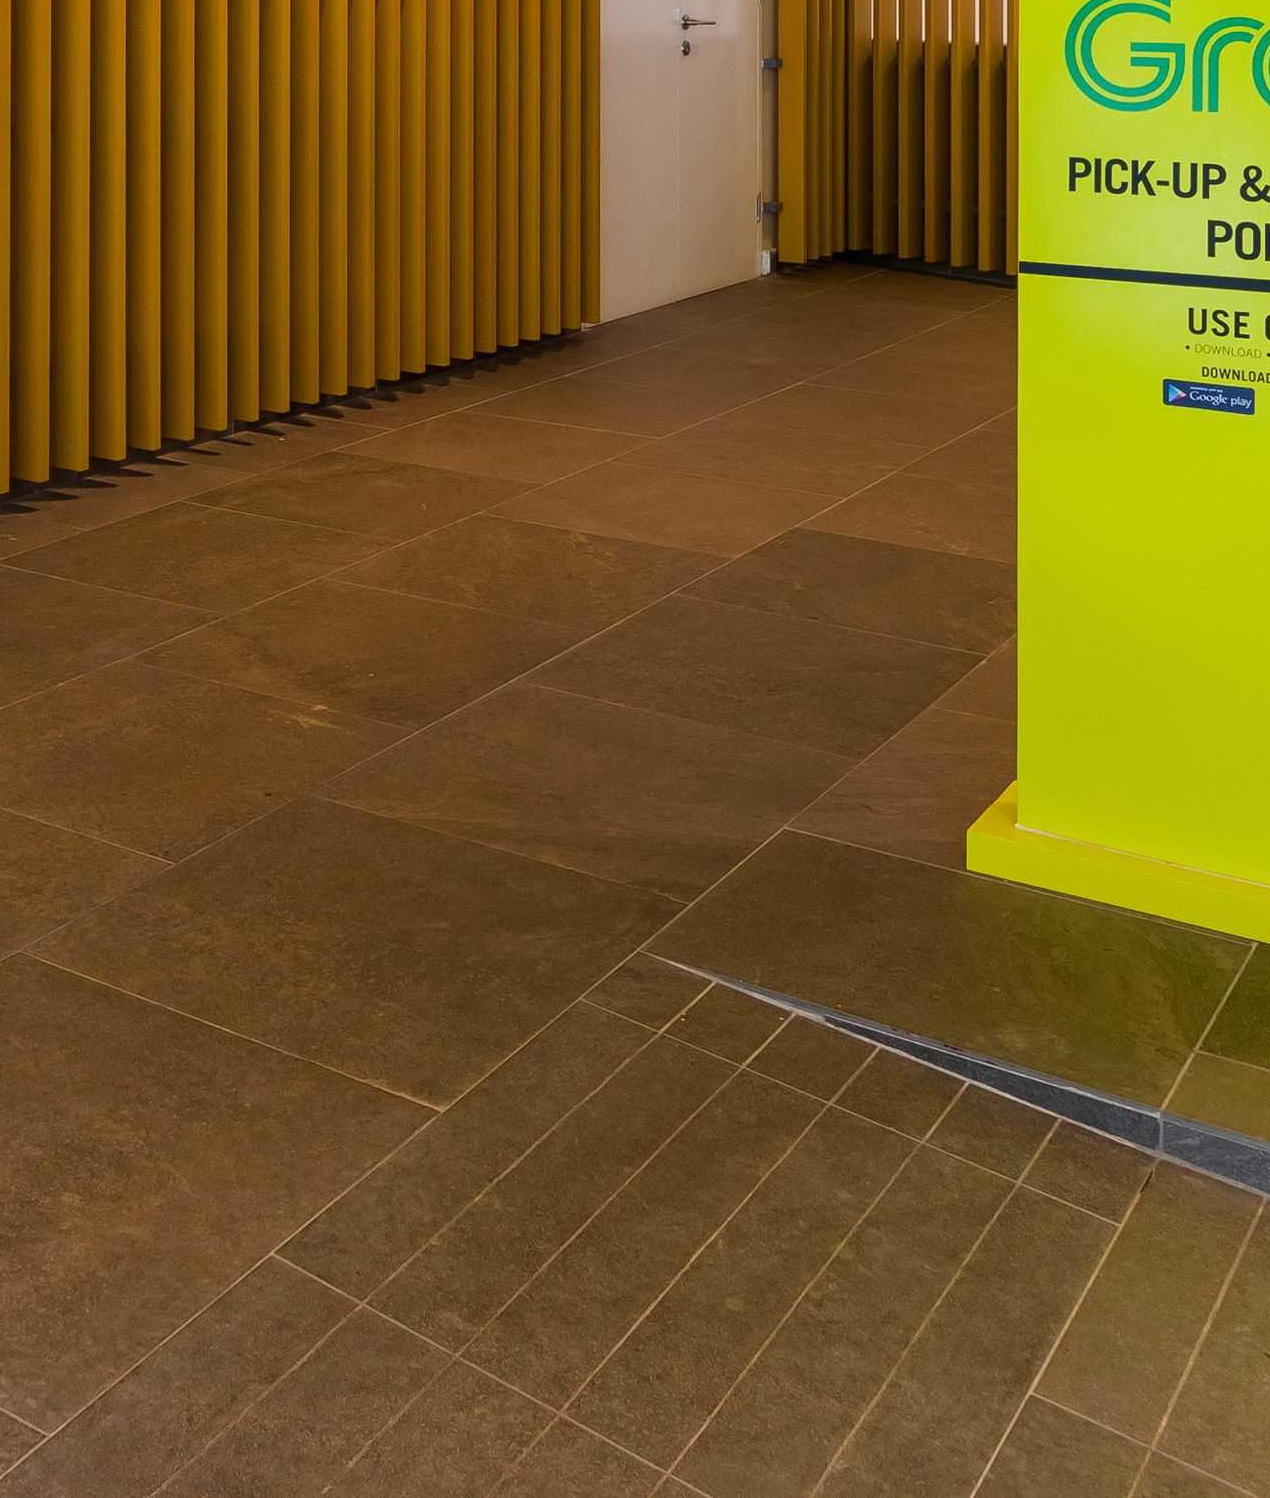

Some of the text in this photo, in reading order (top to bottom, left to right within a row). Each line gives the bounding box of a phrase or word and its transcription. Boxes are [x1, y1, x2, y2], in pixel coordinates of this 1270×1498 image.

[1067, 156, 1227, 200] PICK-UP
[1187, 307, 1251, 339] USE
[1194, 343, 1262, 360] DOWNLOAD
[1189, 390, 1252, 409] Google play
